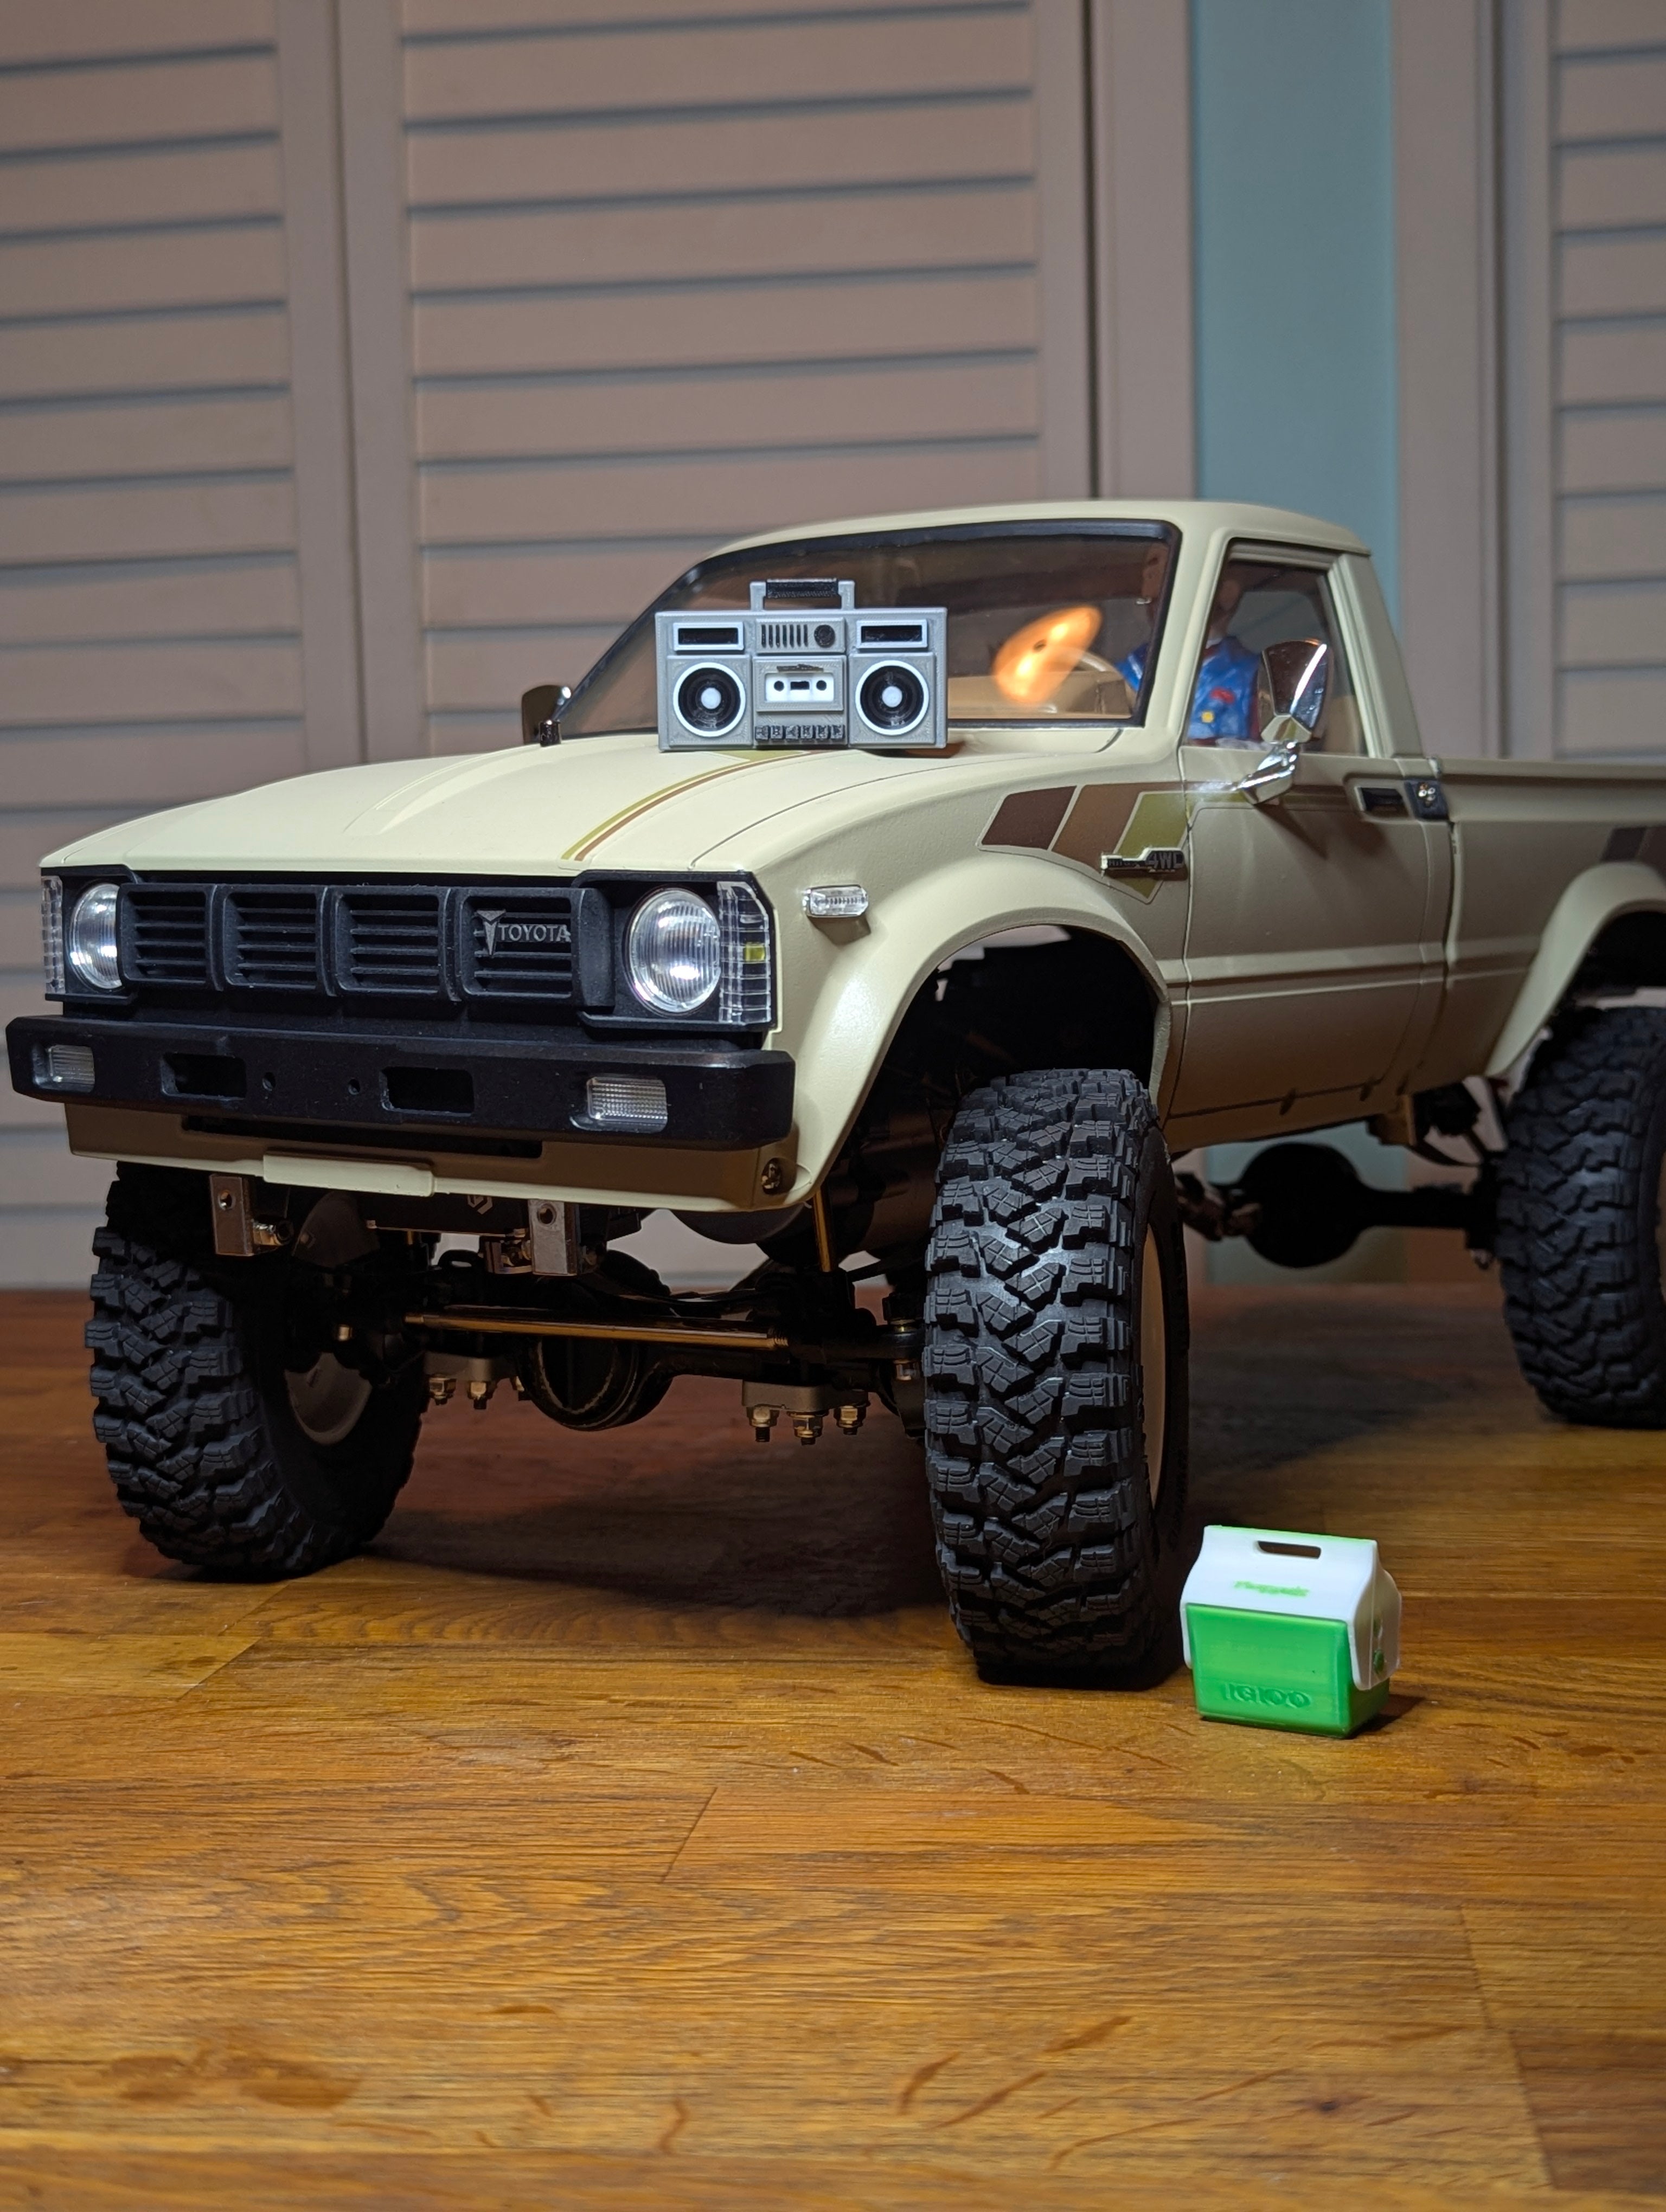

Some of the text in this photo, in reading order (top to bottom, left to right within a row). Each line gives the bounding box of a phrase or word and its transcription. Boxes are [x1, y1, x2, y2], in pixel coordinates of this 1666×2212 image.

[1145, 851, 1184, 869] 4WD
[498, 924, 571, 942] TOYOTA
[1221, 1682, 1311, 1708] IGLOO
